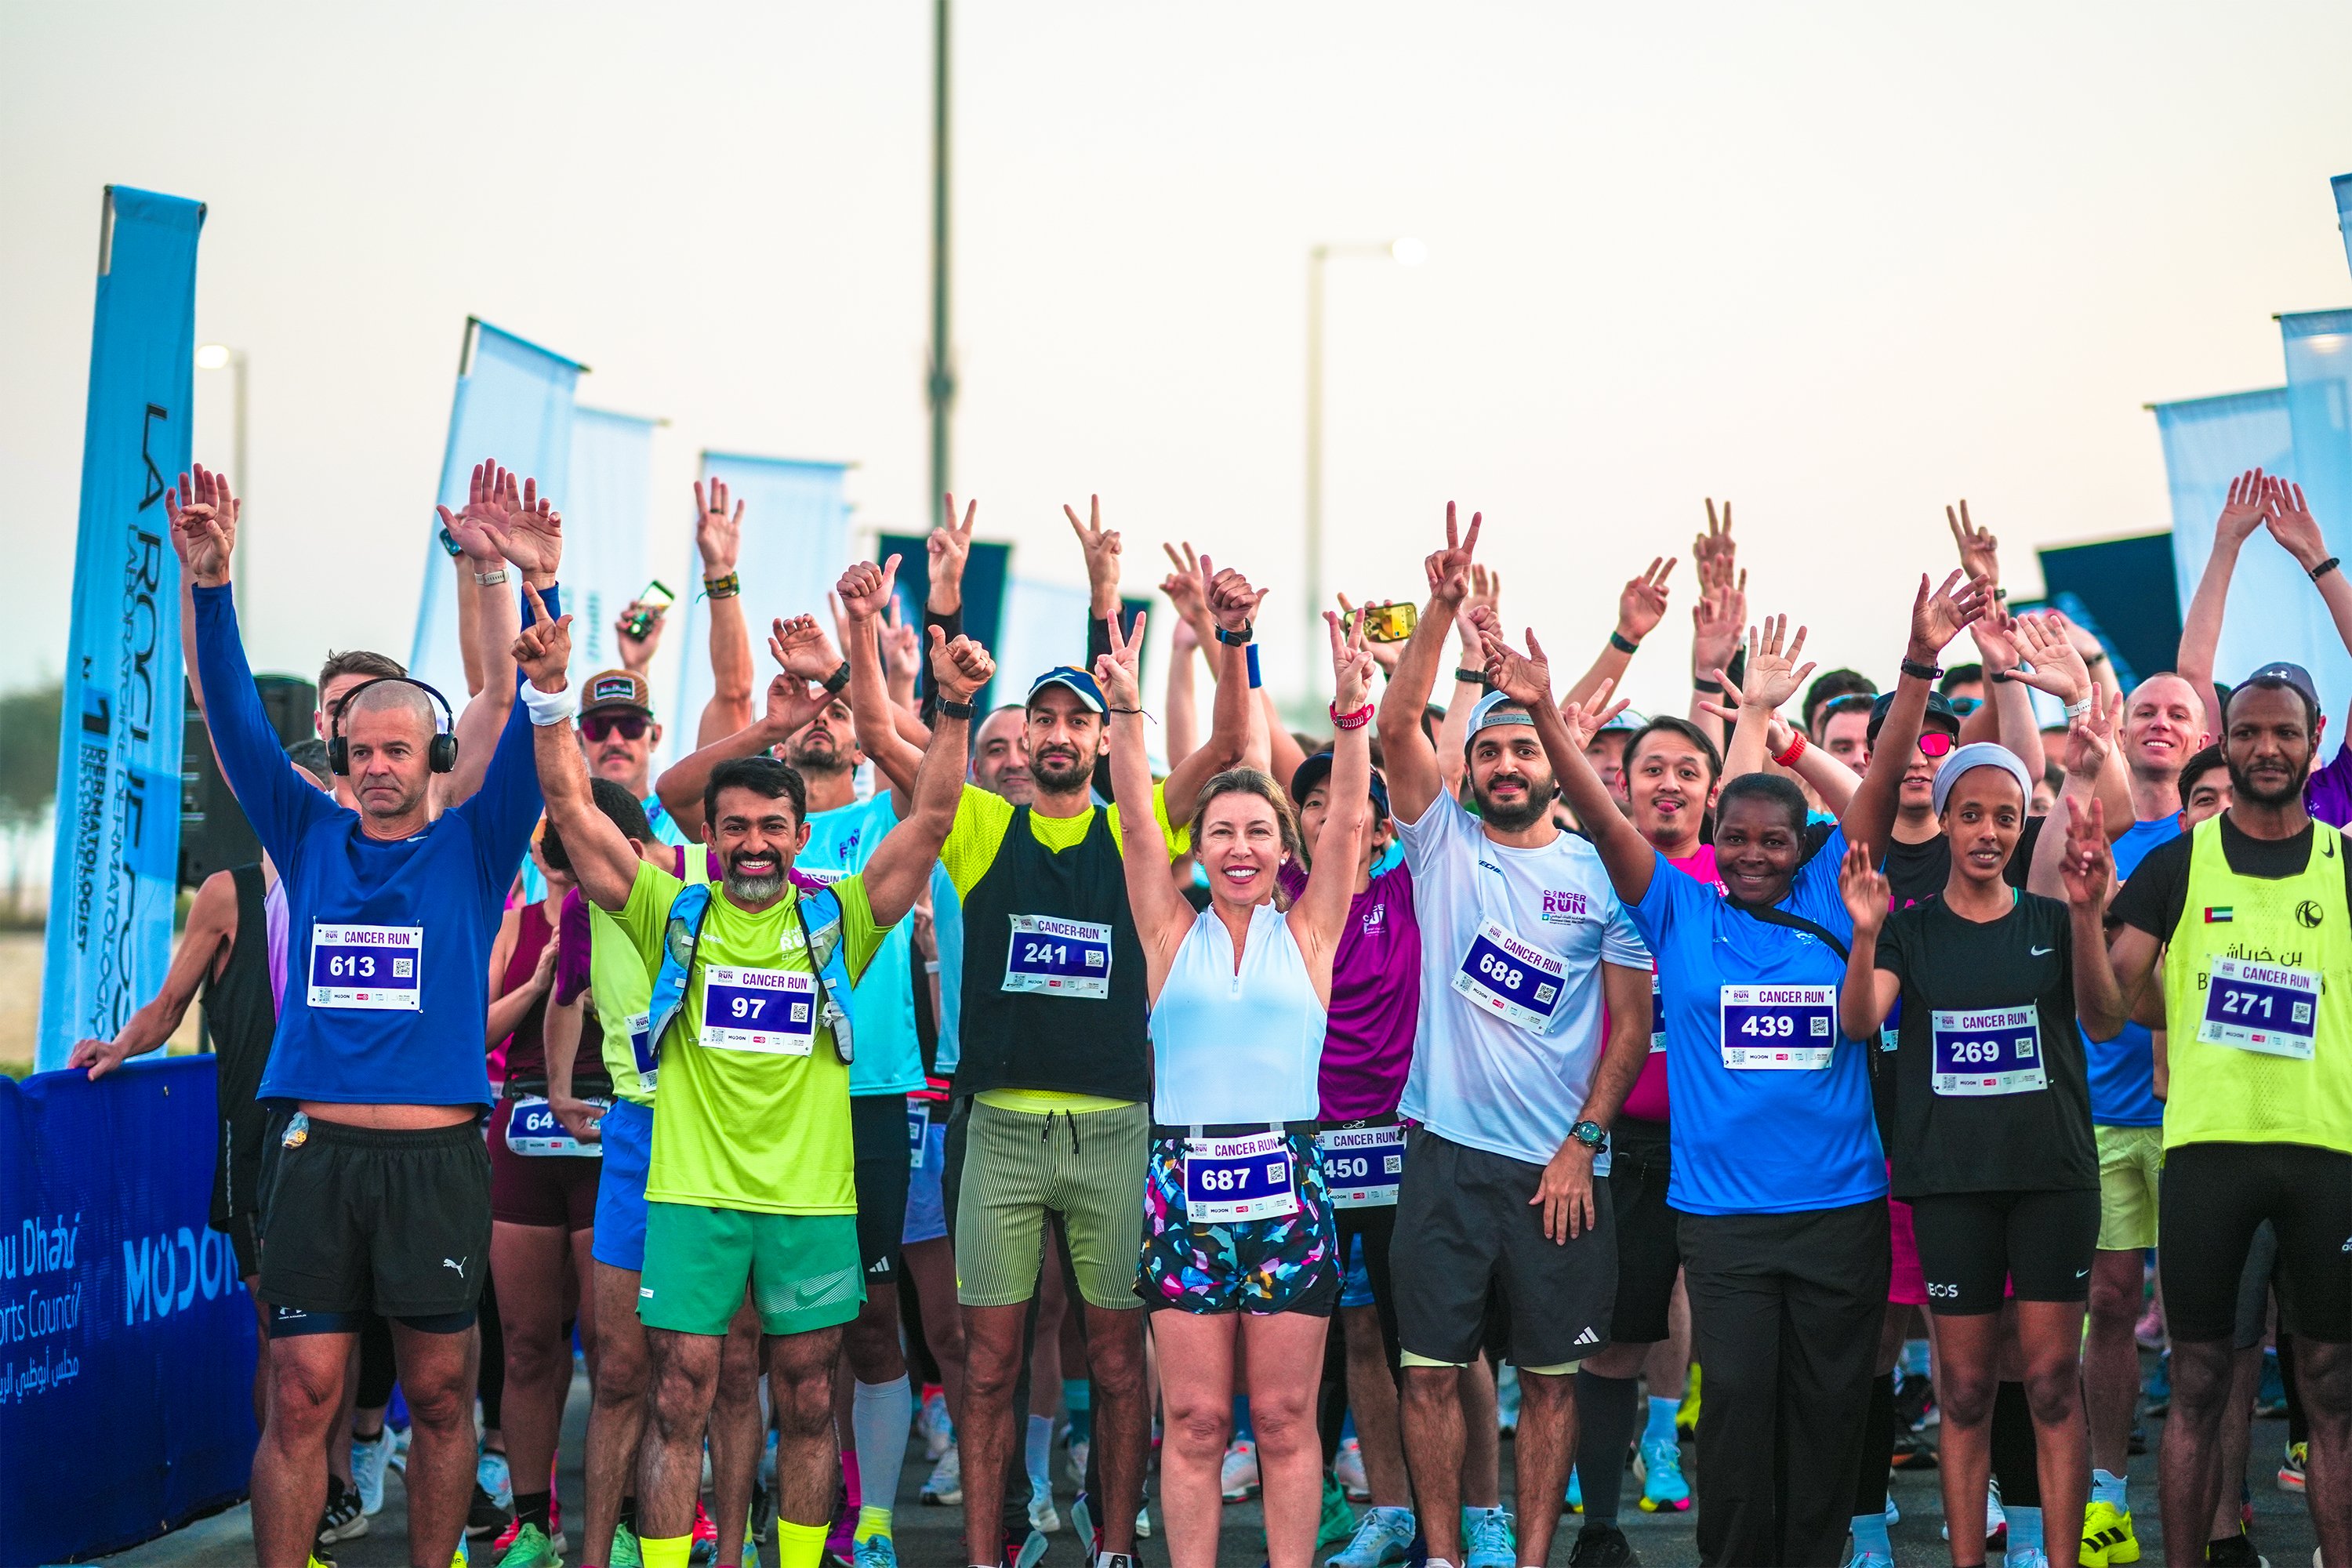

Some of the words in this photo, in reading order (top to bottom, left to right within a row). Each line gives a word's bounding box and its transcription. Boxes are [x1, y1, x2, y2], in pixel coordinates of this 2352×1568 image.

[138, 402, 168, 514] LA
[82, 699, 110, 735] 1
[77, 745, 108, 955] DERMATOLOGIST
[1543, 896, 1586, 915] RUN
[1544, 890, 1586, 902] CANCER
[345, 931, 385, 944] CANCER
[388, 933, 410, 945] RUN
[1038, 920, 1076, 937] CANCER
[1079, 927, 1099, 939] RUN
[780, 931, 807, 952] RU
[1024, 942, 1067, 964] 241
[1504, 938, 1543, 966] CANCER
[1542, 958, 1563, 975] RUN
[2281, 952, 2302, 967] بن
[330, 956, 376, 977] 613
[1479, 953, 1523, 990] 688
[742, 973, 785, 988] CANCER
[788, 977, 808, 989] RUN
[2243, 966, 2288, 985] CANCER
[2289, 974, 2310, 989] RUN
[1759, 991, 1802, 1003] CANCER
[1805, 991, 1824, 1003] RUN
[2222, 990, 2274, 1018] 271
[731, 997, 767, 1019] 97
[1741, 1015, 1794, 1036] 439
[1962, 1014, 2005, 1029] CANCER
[2008, 1012, 2027, 1026] RUN
[1951, 1040, 1999, 1062] 269
[526, 1112, 564, 1131] 64
[1215, 1142, 1256, 1156] CANCER
[1258, 1138, 1278, 1152] RUN
[1334, 1134, 1374, 1147] CANCER
[1376, 1131, 1396, 1144] RUN
[1323, 1157, 1368, 1178] 450
[1201, 1167, 1250, 1190] 687
[23, 1212, 80, 1276] Dhabi
[1926, 1283, 1958, 1298] EOS
[29, 1282, 82, 1338] Council
